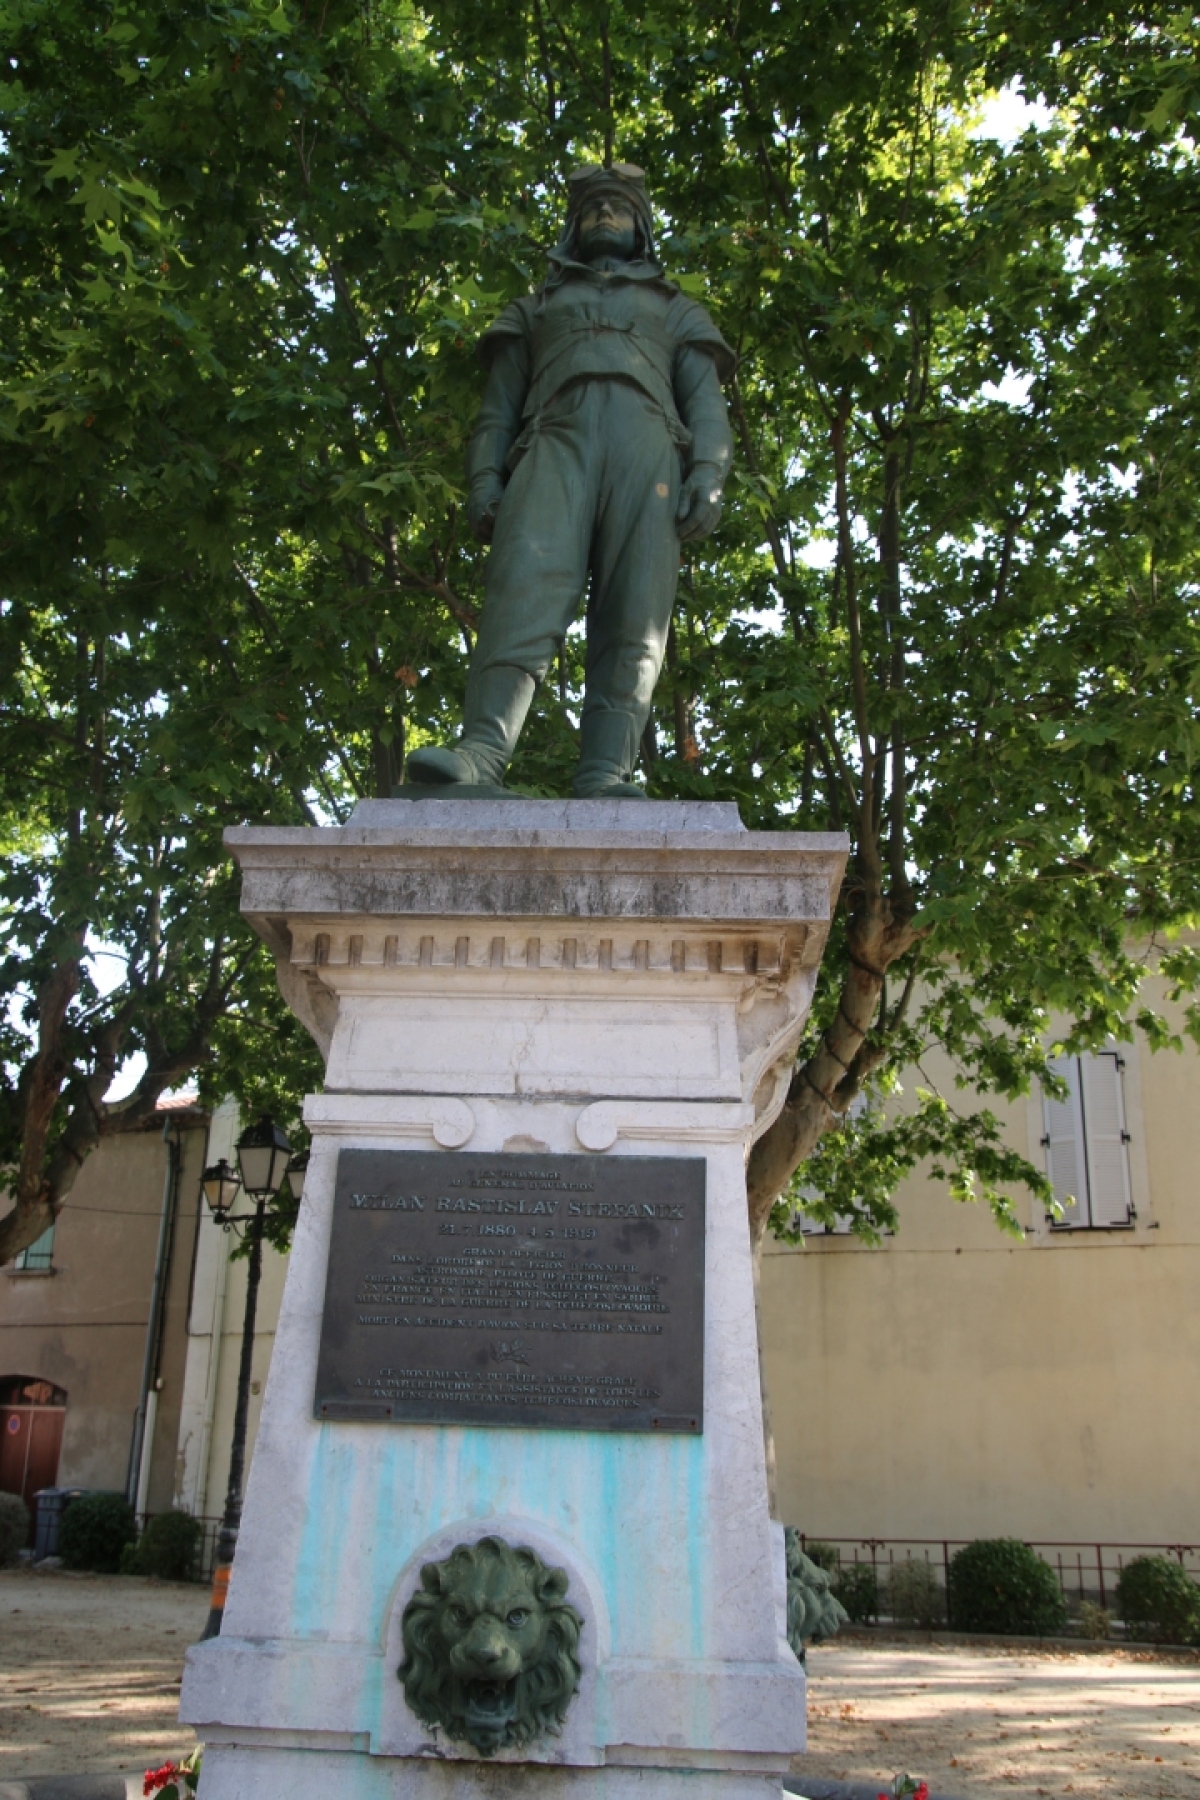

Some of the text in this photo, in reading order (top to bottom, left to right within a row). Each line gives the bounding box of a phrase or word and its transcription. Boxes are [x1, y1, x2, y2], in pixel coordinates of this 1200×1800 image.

[349, 1194, 426, 1211] MILAN
[435, 1196, 559, 1215] RASTISLAV
[462, 1248, 506, 1256] GRAND
[493, 1269, 537, 1279] PILOTE
[542, 1271, 559, 1281] DE
[355, 1294, 418, 1304] MINISTRE
[440, 1297, 457, 1306] LA
[461, 1298, 510, 1308] GUERRE
[357, 1315, 390, 1324] MORT
[393, 1316, 411, 1326] EN
[413, 1317, 473, 1328] ACCIDENT
[524, 1321, 550, 1331] SUR
[552, 1322, 568, 1331] SA
[571, 1323, 613, 1333] TERRE
[616, 1324, 663, 1334] NATALE
[379, 1368, 396, 1377] CE
[398, 1368, 471, 1380] MONUMENT
[487, 1372, 503, 1381] PU
[386, 1379, 474, 1391] PARTICIPATION
[583, 1386, 599, 1395] DE
[369, 1389, 424, 1399] ANCIENS
[427, 1390, 518, 1402] COMBATTANTS
